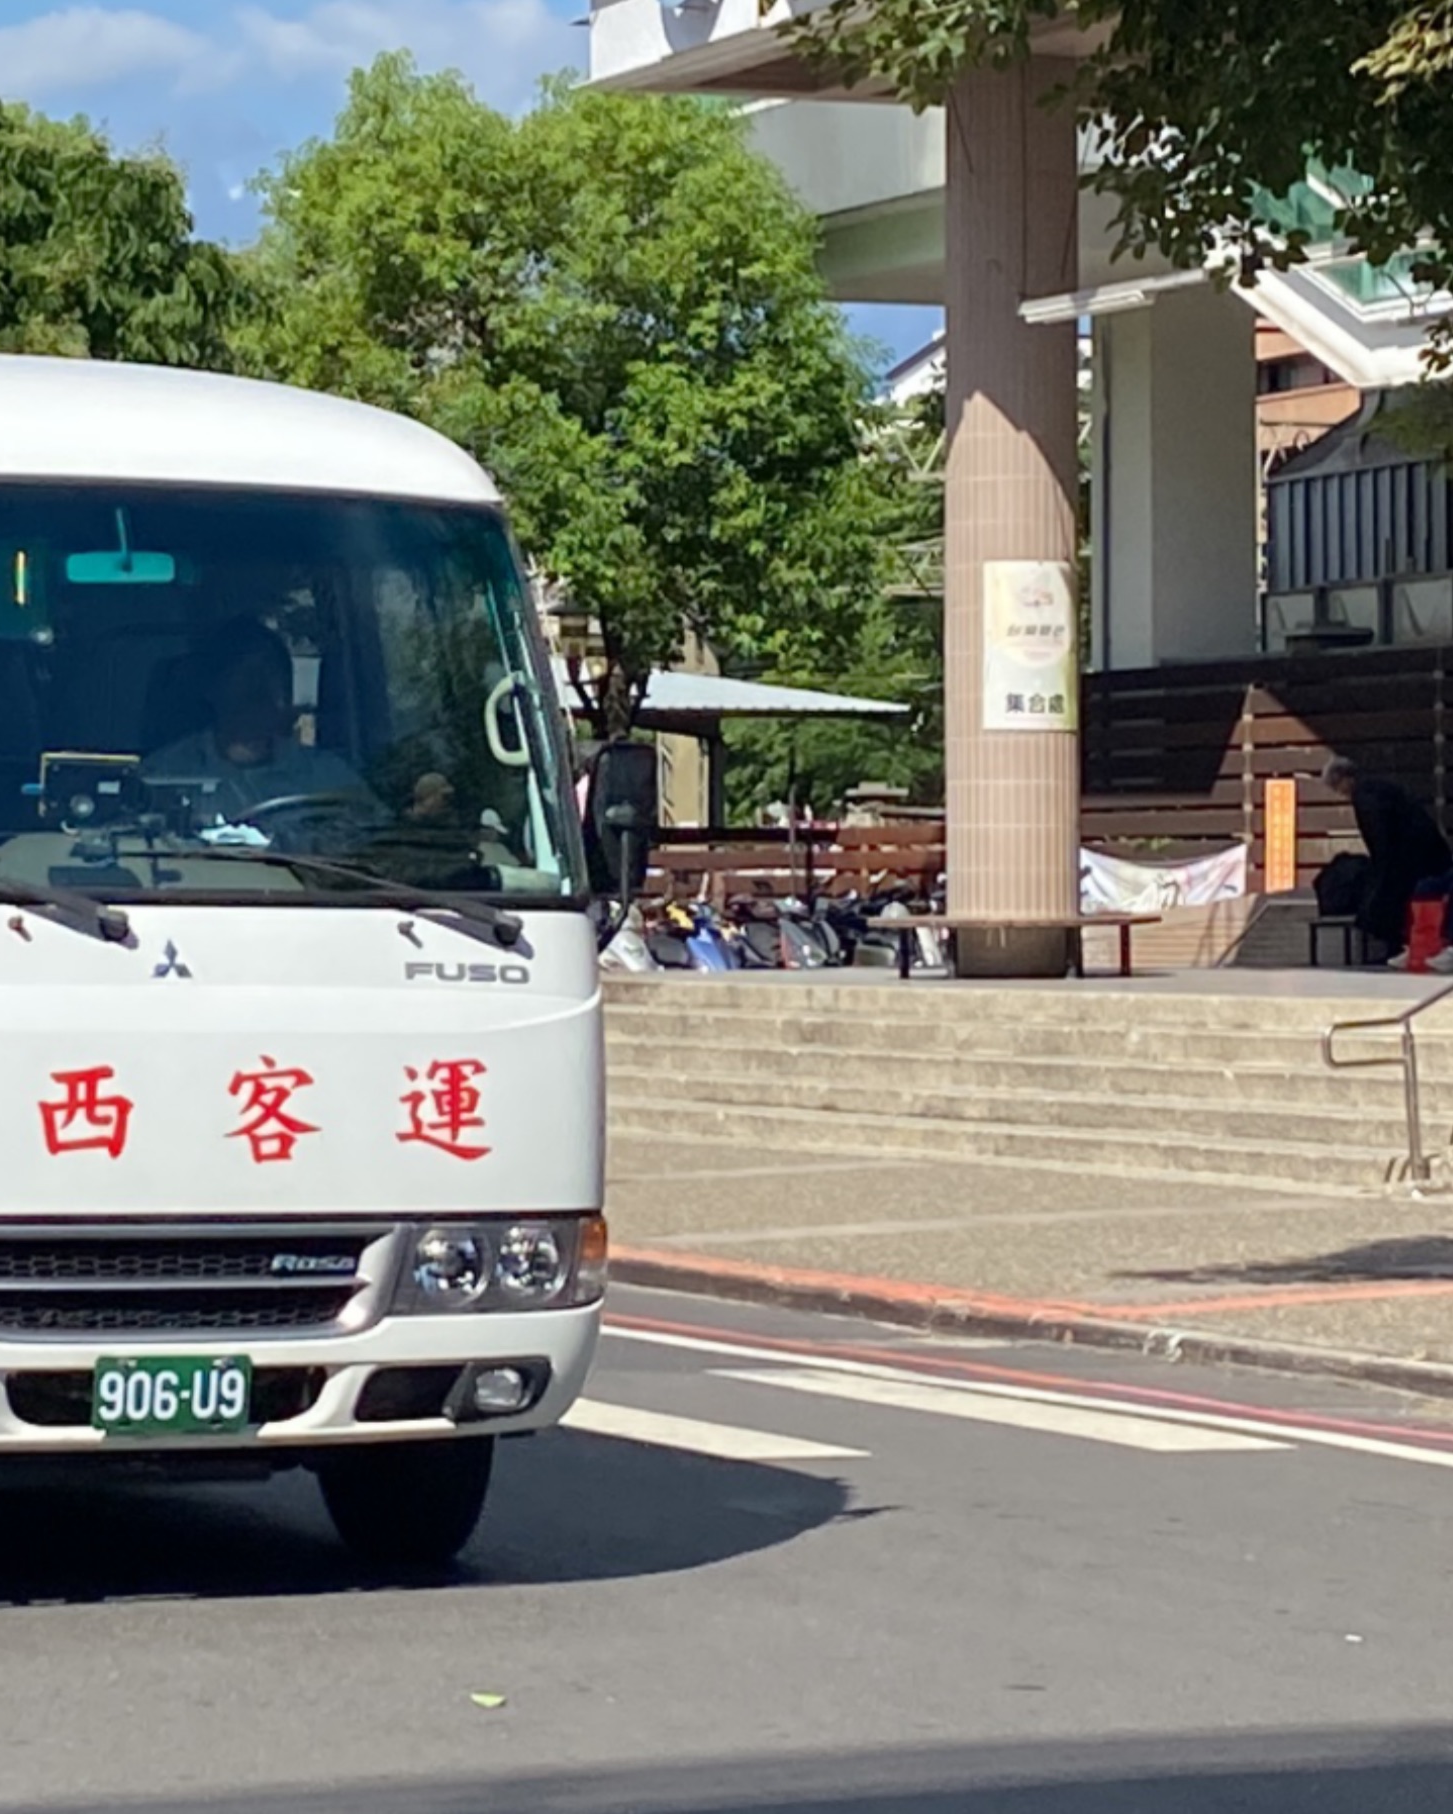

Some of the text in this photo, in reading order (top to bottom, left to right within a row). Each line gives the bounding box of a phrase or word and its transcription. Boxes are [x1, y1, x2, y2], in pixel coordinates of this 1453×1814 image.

[404, 961, 530, 984] FUSO
[271, 1254, 355, 1271] Rosa
[99, 1369, 245, 1421] 906-U9
